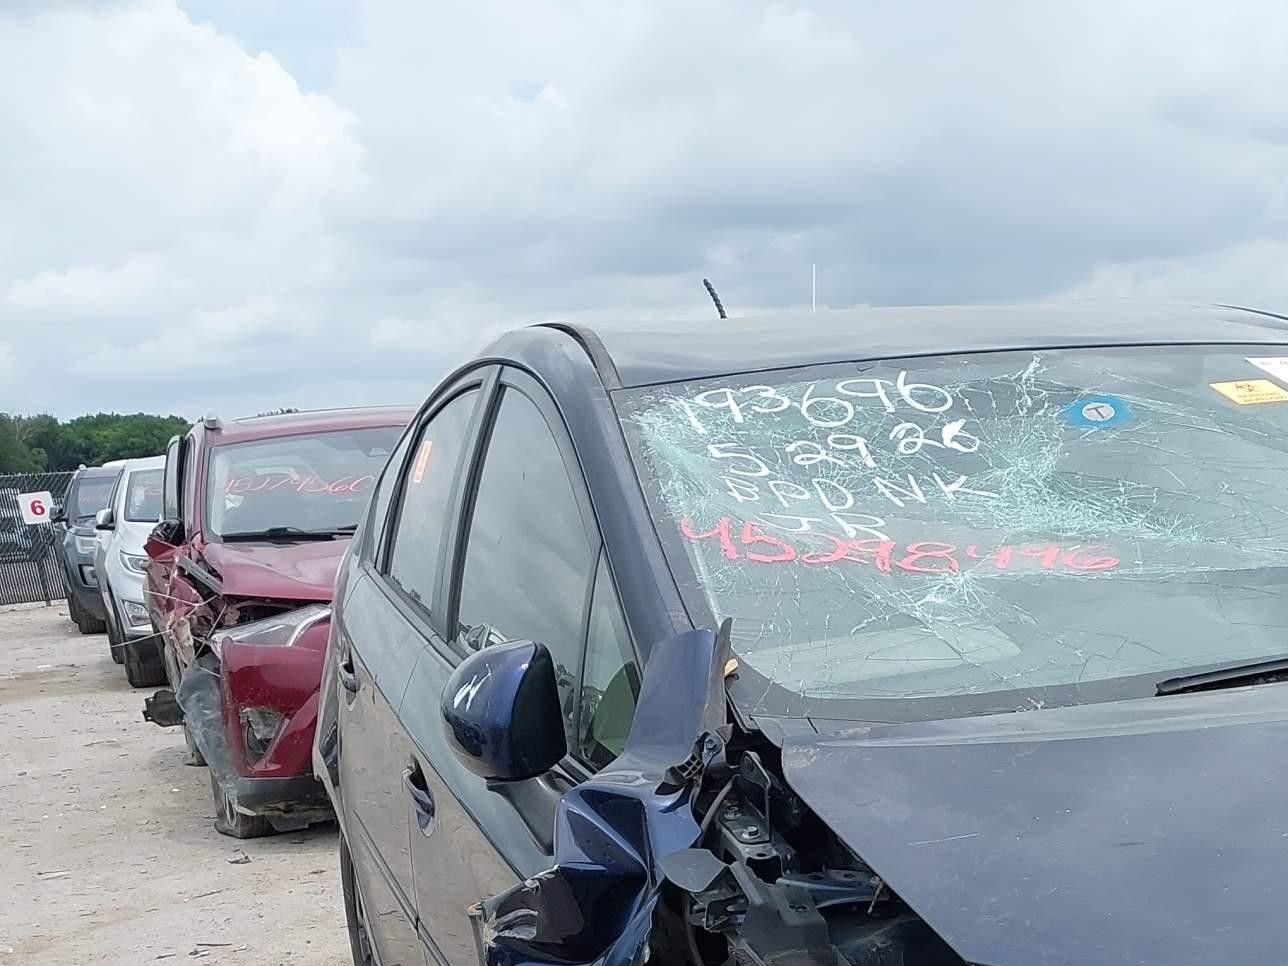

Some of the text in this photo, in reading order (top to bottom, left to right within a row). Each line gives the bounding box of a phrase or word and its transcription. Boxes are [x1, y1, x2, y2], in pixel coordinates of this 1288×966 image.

[686, 371, 953, 434] 193696
[1086, 405, 1105, 419] T
[708, 419, 980, 477] 5 29 26
[30, 500, 46, 516] 6
[680, 516, 1121, 574] 45298496
